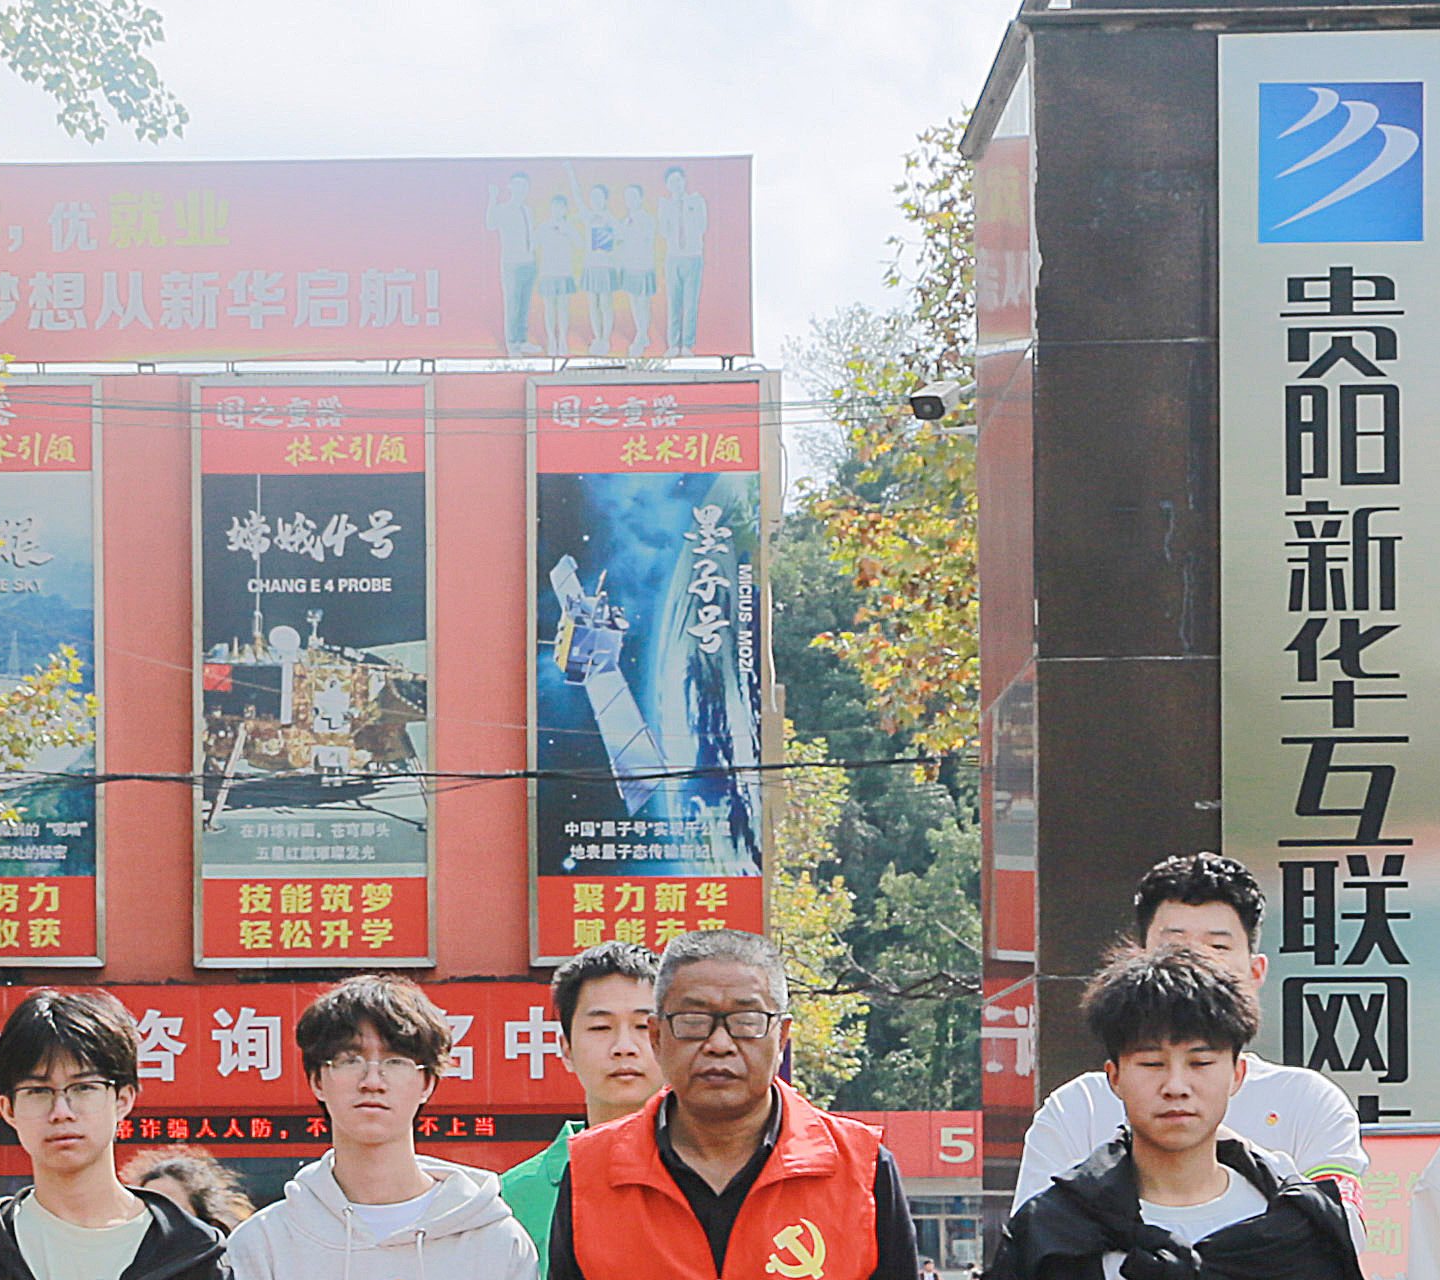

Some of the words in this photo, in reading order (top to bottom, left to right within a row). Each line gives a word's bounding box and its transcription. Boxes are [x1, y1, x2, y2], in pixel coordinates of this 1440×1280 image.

[551, 394, 685, 429] 国之重器
[284, 432, 408, 468] 技术引领
[619, 431, 744, 468] 技术引领
[225, 509, 402, 563] 嫦娥4号
[247, 578, 306, 593] CHANG
[310, 578, 321, 592] E
[324, 578, 334, 592] 4
[338, 577, 393, 593] PROBE
[683, 504, 733, 655] 墨子号
[738, 563, 754, 623] MICIUS
[1278, 265, 1414, 1125] 贵阳新华互联网
[238, 882, 394, 914] 技能筑梦
[572, 882, 729, 914] 聚力新华
[239, 918, 394, 950] 轻松升学
[938, 1126, 976, 1163] 5
